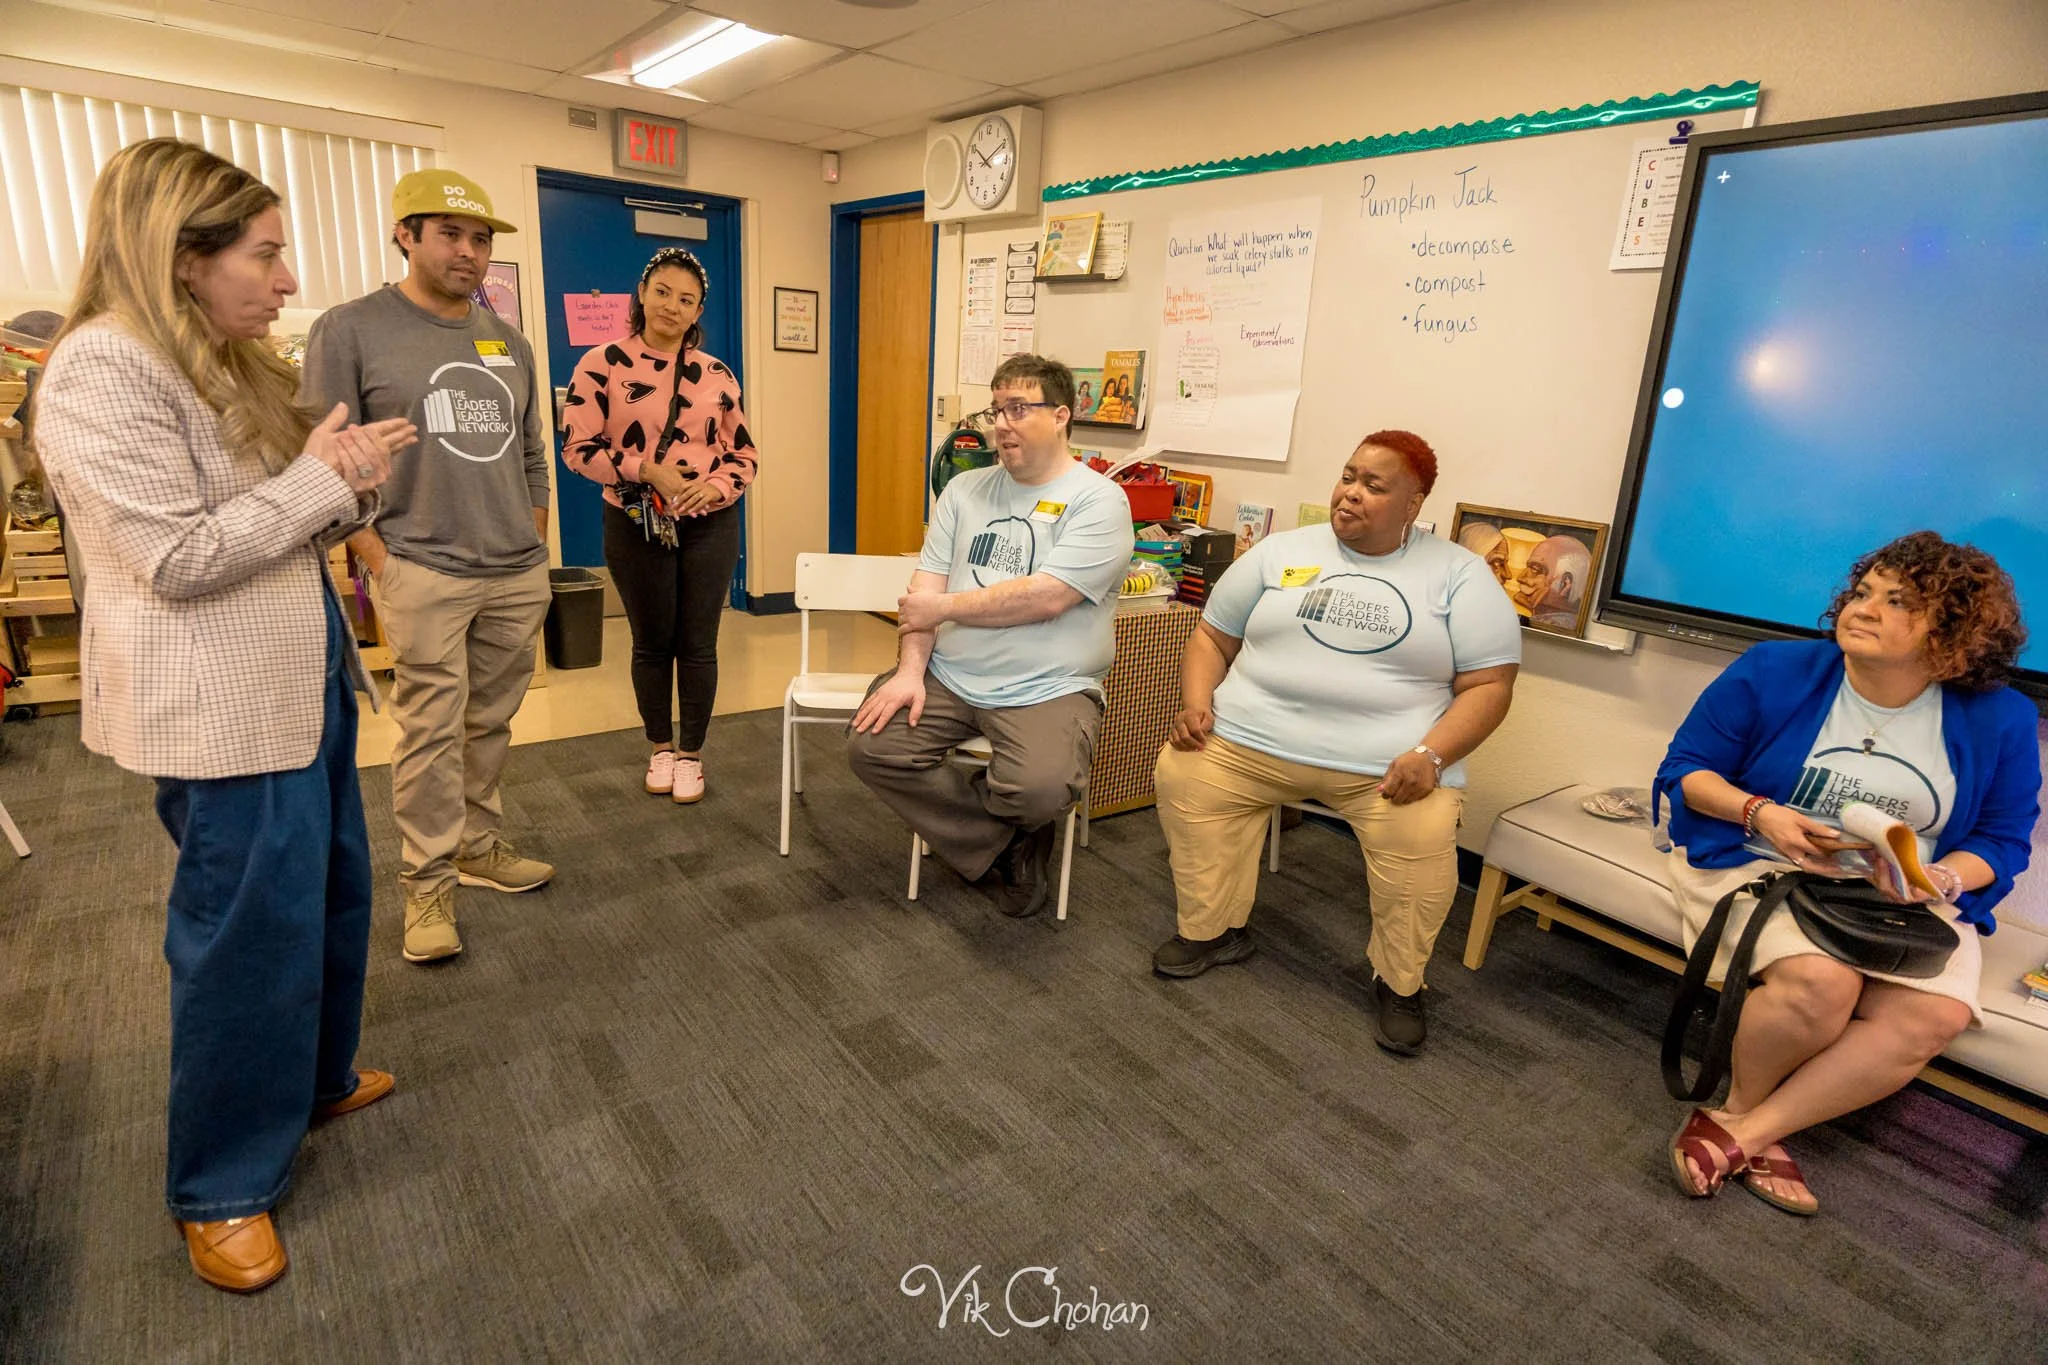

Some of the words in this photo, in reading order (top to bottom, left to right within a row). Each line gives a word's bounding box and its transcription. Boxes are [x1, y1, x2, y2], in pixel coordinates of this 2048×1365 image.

[986, 125, 992, 135] 12
[629, 120, 678, 168] EXIT
[443, 185, 465, 196] DO
[1360, 174, 1436, 223] Pumpkin
[1453, 166, 1498, 209] Jack
[1169, 237, 1203, 257] Question
[1207, 232, 1226, 251] What
[1234, 233, 1248, 248] will
[1252, 231, 1283, 245] happen
[1288, 224, 1313, 241] when
[1416, 231, 1515, 260] decompose
[1207, 255, 1218, 263] we
[1244, 248, 1266, 266] celery
[1269, 245, 1294, 260] stalks
[1299, 246, 1309, 256] in
[1415, 269, 1487, 299] compost
[1414, 303, 1478, 343] fungus
[448, 389, 467, 399] THE
[453, 400, 499, 411] LEADERS
[456, 411, 501, 422] READERS
[458, 422, 510, 433] NETWORK
[1335, 590, 1357, 600] THE
[1328, 606, 1390, 624] READERS
[1332, 598, 1390, 614] LEADERS
[1326, 615, 1398, 636] NETWORK
[1834, 771, 1863, 788] THE
[1829, 786, 1910, 811] LEADERS
